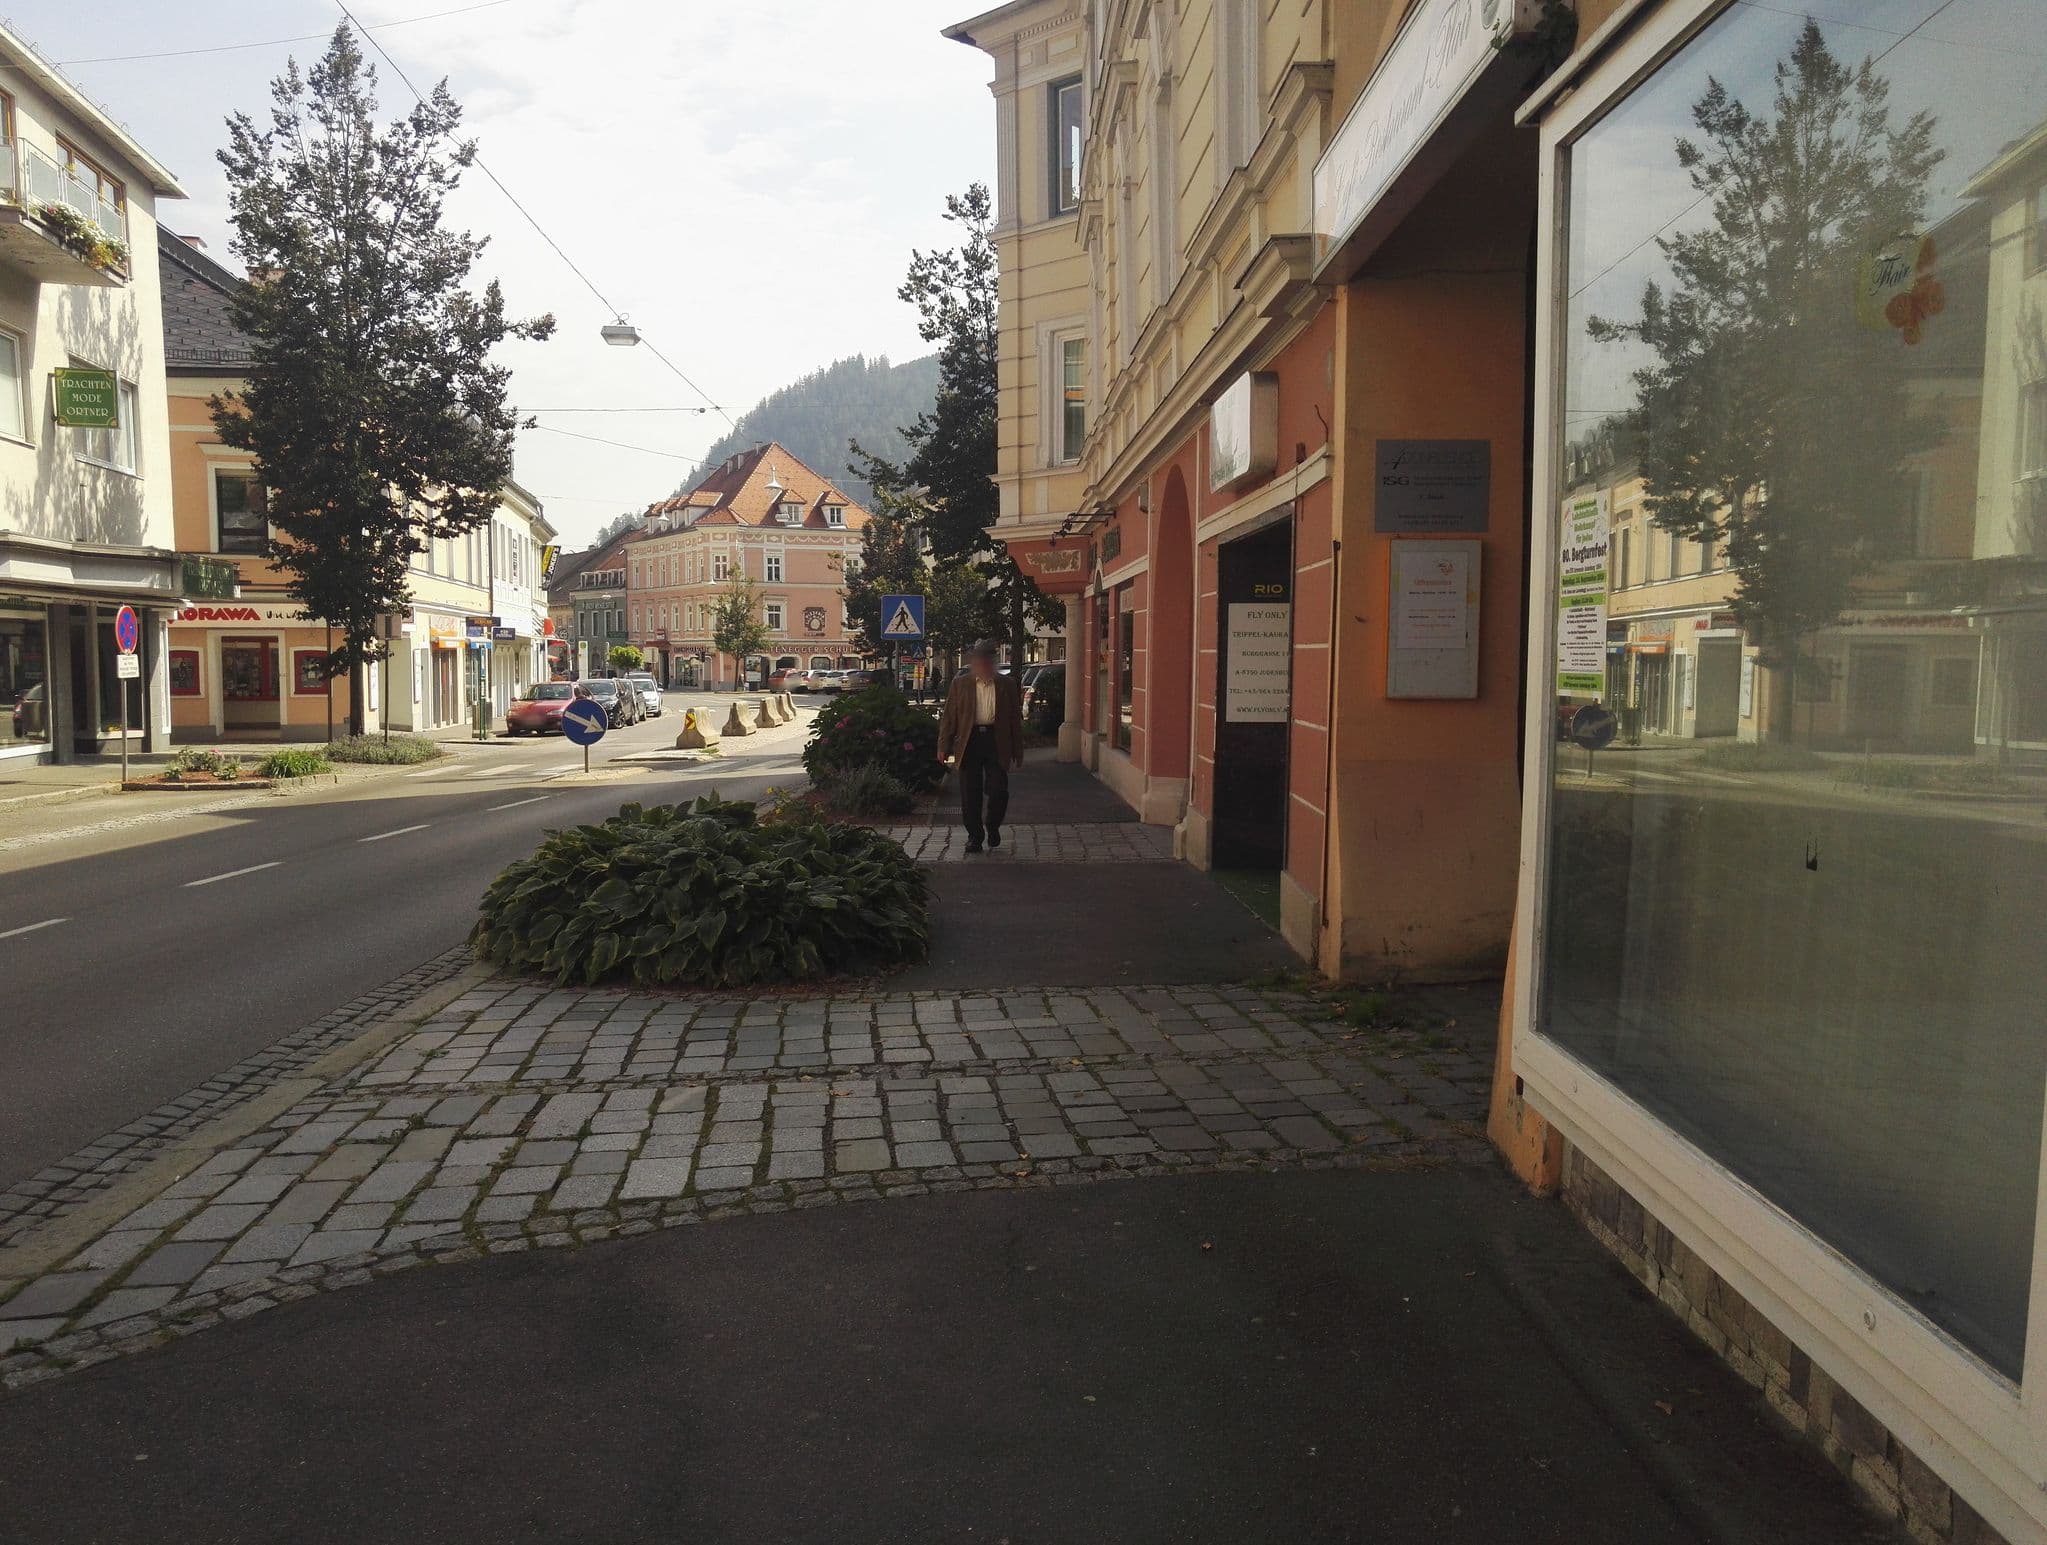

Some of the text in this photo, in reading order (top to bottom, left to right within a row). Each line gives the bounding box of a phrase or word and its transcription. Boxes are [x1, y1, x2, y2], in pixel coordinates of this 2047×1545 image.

[61, 378, 112, 390] TRACHTEN
[72, 392, 102, 404] MODE
[66, 405, 109, 418] ORTNER
[1254, 584, 1284, 594] RIO
